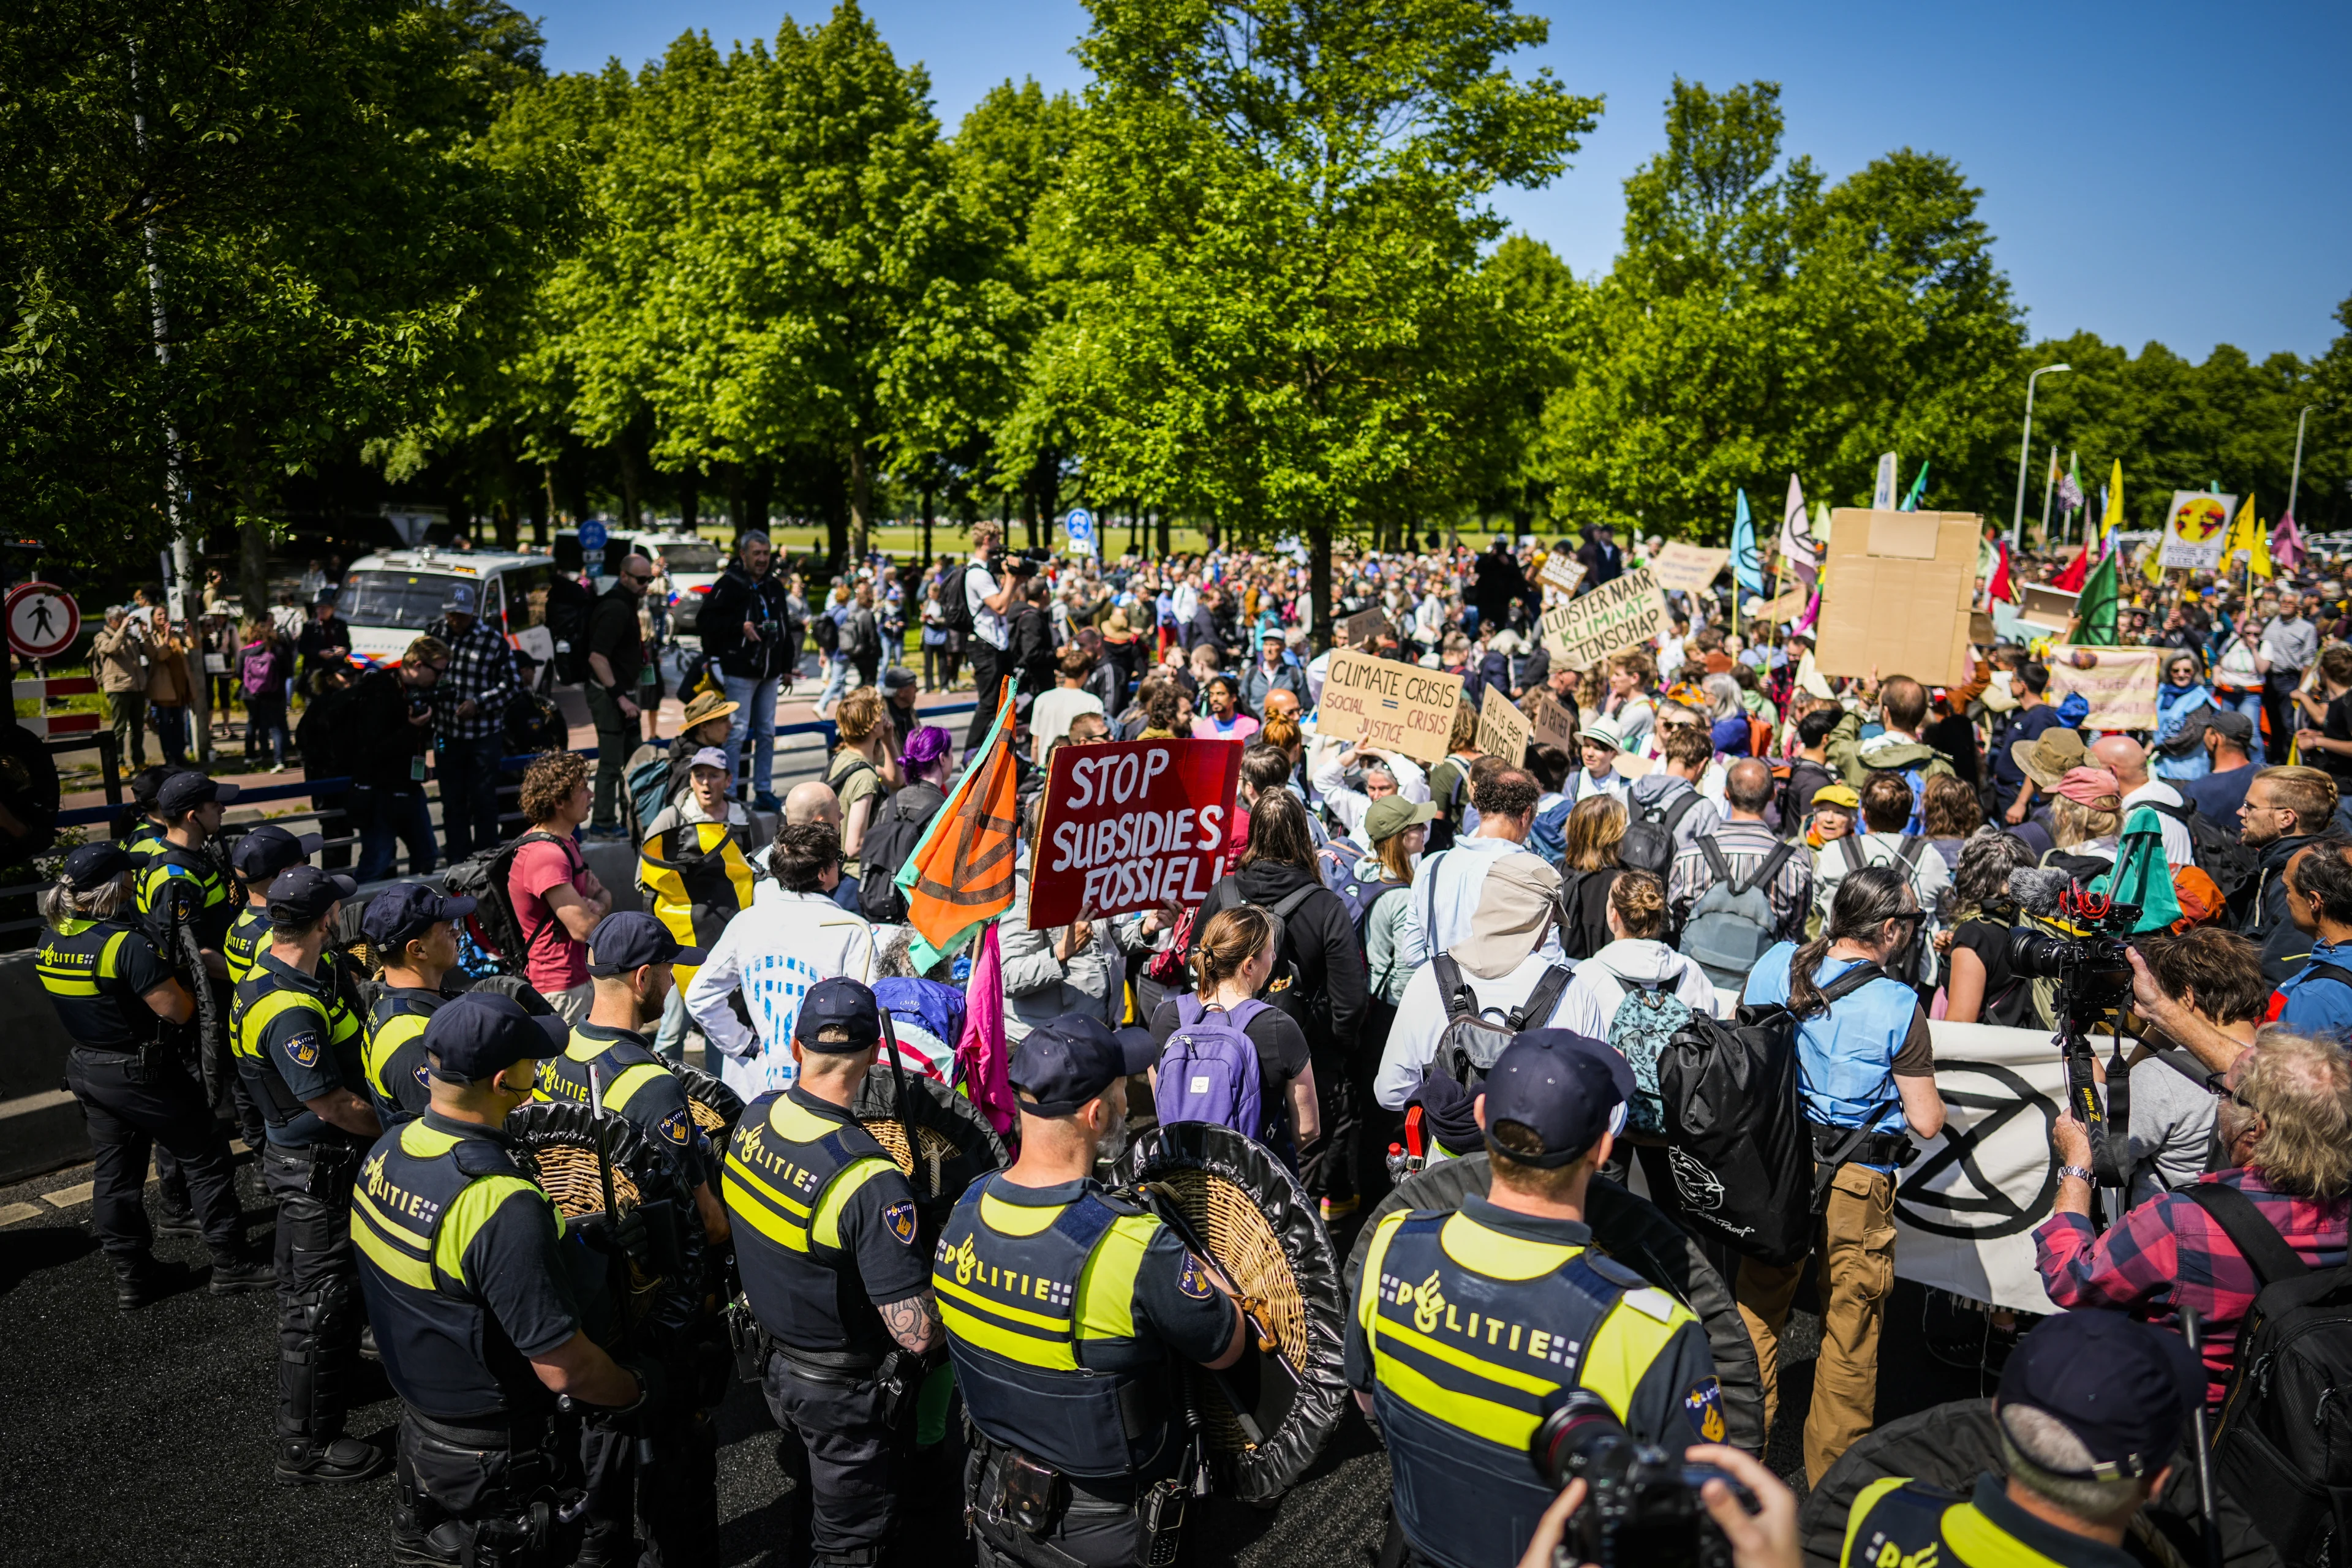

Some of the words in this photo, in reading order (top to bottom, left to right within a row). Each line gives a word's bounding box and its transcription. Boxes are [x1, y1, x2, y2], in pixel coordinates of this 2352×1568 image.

[1545, 589, 1609, 634] LUISTER
[1609, 568, 1654, 604] NAAR
[1560, 594, 1653, 647] KLIMAAT-
[1325, 692, 1365, 715] SOCIAL
[1331, 660, 1403, 696] CLIMATE
[1405, 677, 1455, 709] CRISIS
[1357, 717, 1404, 744] JUSTICE
[1407, 709, 1448, 736] CRISIS
[1487, 697, 1498, 721] dit
[1498, 709, 1506, 729] is
[1507, 720, 1523, 747] een
[1548, 707, 1568, 740] RATHER
[1066, 748, 1169, 810] STOP
[1052, 805, 1224, 872] SUBSIDIES
[40, 946, 85, 966] POLITIE
[288, 1035, 314, 1048] POLITIE
[540, 1060, 589, 1102] POLITIE
[661, 1109, 684, 1129] POLITIE
[2082, 1088, 2095, 1110] Nikon
[2089, 1112, 2101, 1123] Z
[737, 1125, 809, 1188] POLITIE
[365, 1153, 423, 1217] POLITIE
[887, 1204, 913, 1216] POLITIE
[944, 1239, 1050, 1301] POLITIE
[1396, 1276, 1551, 1359] POLITIE
